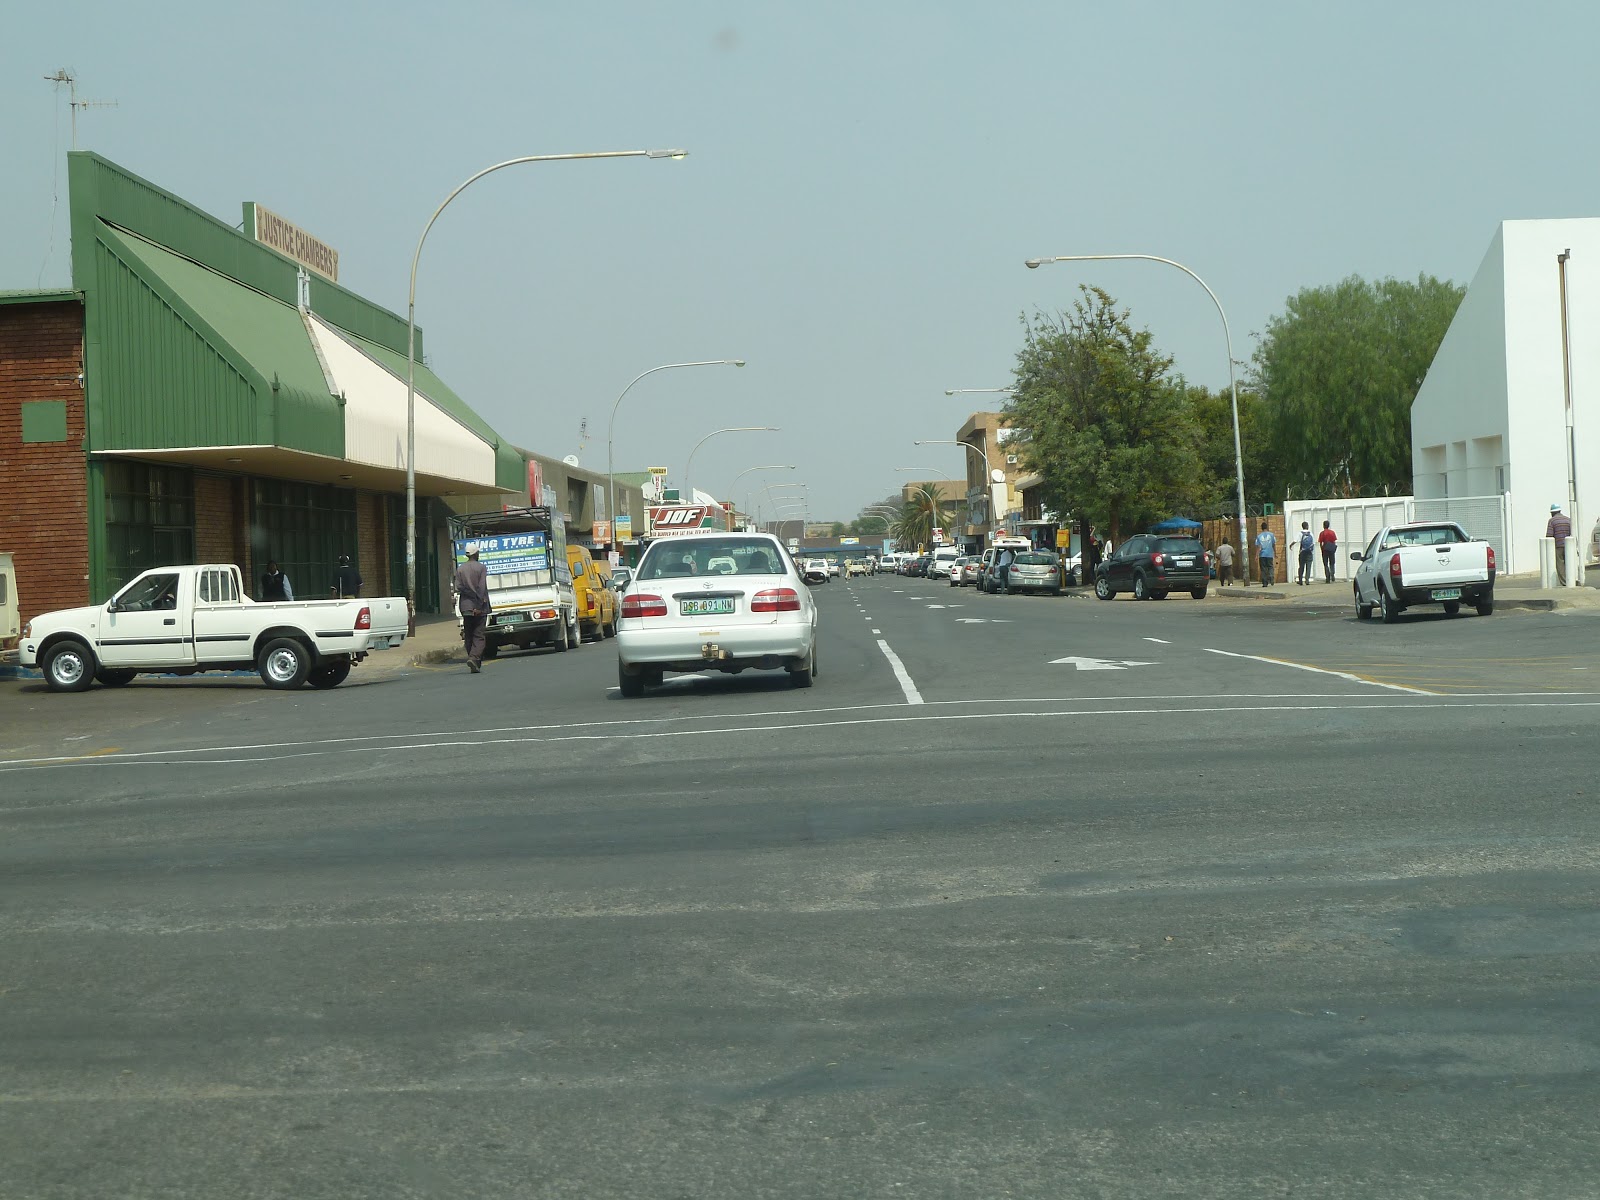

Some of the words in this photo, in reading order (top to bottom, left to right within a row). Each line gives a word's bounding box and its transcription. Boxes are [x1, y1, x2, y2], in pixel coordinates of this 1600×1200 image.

[263, 212, 295, 255] JUSTICE
[295, 230, 333, 276] CHAMBERS
[502, 535, 535, 546] TYRE
[683, 601, 698, 611] DSB
[703, 600, 718, 610] 091
[722, 600, 732, 609] NW
